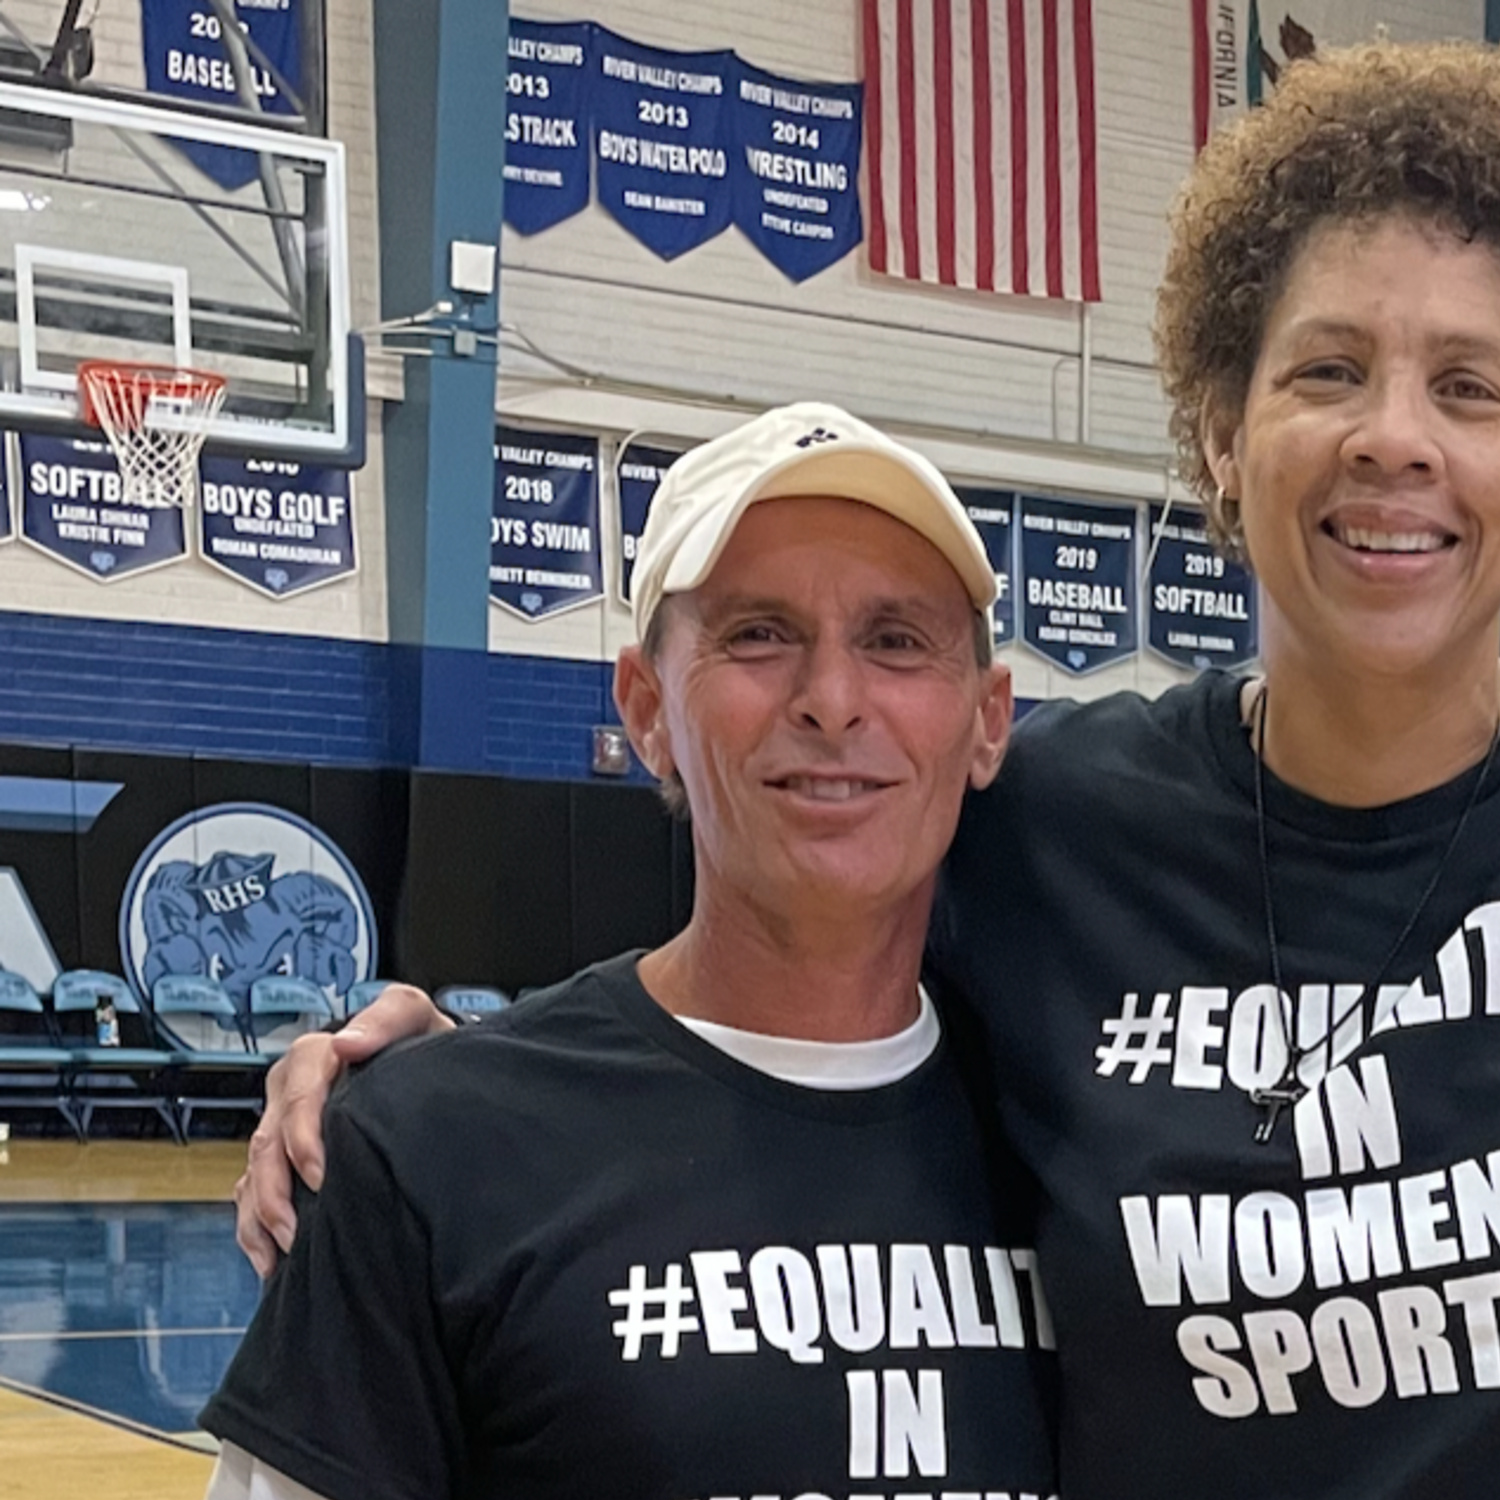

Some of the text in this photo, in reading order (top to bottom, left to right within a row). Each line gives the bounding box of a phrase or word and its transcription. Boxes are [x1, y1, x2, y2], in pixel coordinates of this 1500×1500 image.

[508, 36, 584, 66] LLEY CHAMPS
[1213, 3, 1238, 108] IFORNIA
[168, 49, 276, 96] BASEBLL
[505, 72, 550, 98] 013
[603, 55, 723, 95] RIVER VALLEY CHAMPS
[638, 99, 689, 128] 2013
[740, 80, 854, 119] RIVER VALLEY CHAMPS
[521, 115, 577, 147] TRACK
[772, 119, 819, 149] 2014
[600, 129, 727, 178] BOYS WATER POLO
[745, 146, 848, 191] WRESTLING
[763, 188, 829, 213] UNDEFEATED
[501, 446, 545, 466] VALLEY
[545, 451, 594, 471] CHAMPS
[621, 462, 656, 482] RIVER
[202, 482, 346, 526] BOYS GOLF
[505, 475, 554, 503] 2018
[52, 503, 98, 524] LAURA
[233, 516, 315, 539] UNDEFEATED
[968, 506, 1010, 525] CHAMPS
[1023, 514, 1132, 540] RIVER VALLEY CHAMPS
[58, 522, 111, 544] KRISTIE
[491, 517, 527, 547] OYS
[531, 520, 592, 552] SWIM
[1055, 545, 1099, 571] 2019
[1184, 552, 1224, 578] 2019
[1027, 577, 1128, 613] BASEBALL
[1154, 584, 1248, 620] SOFTBALL
[203, 874, 267, 913] RHS
[1293, 1053, 1402, 1180] IN
[608, 1244, 1057, 1364] #EQUALIT
[846, 1368, 948, 1479] IN
